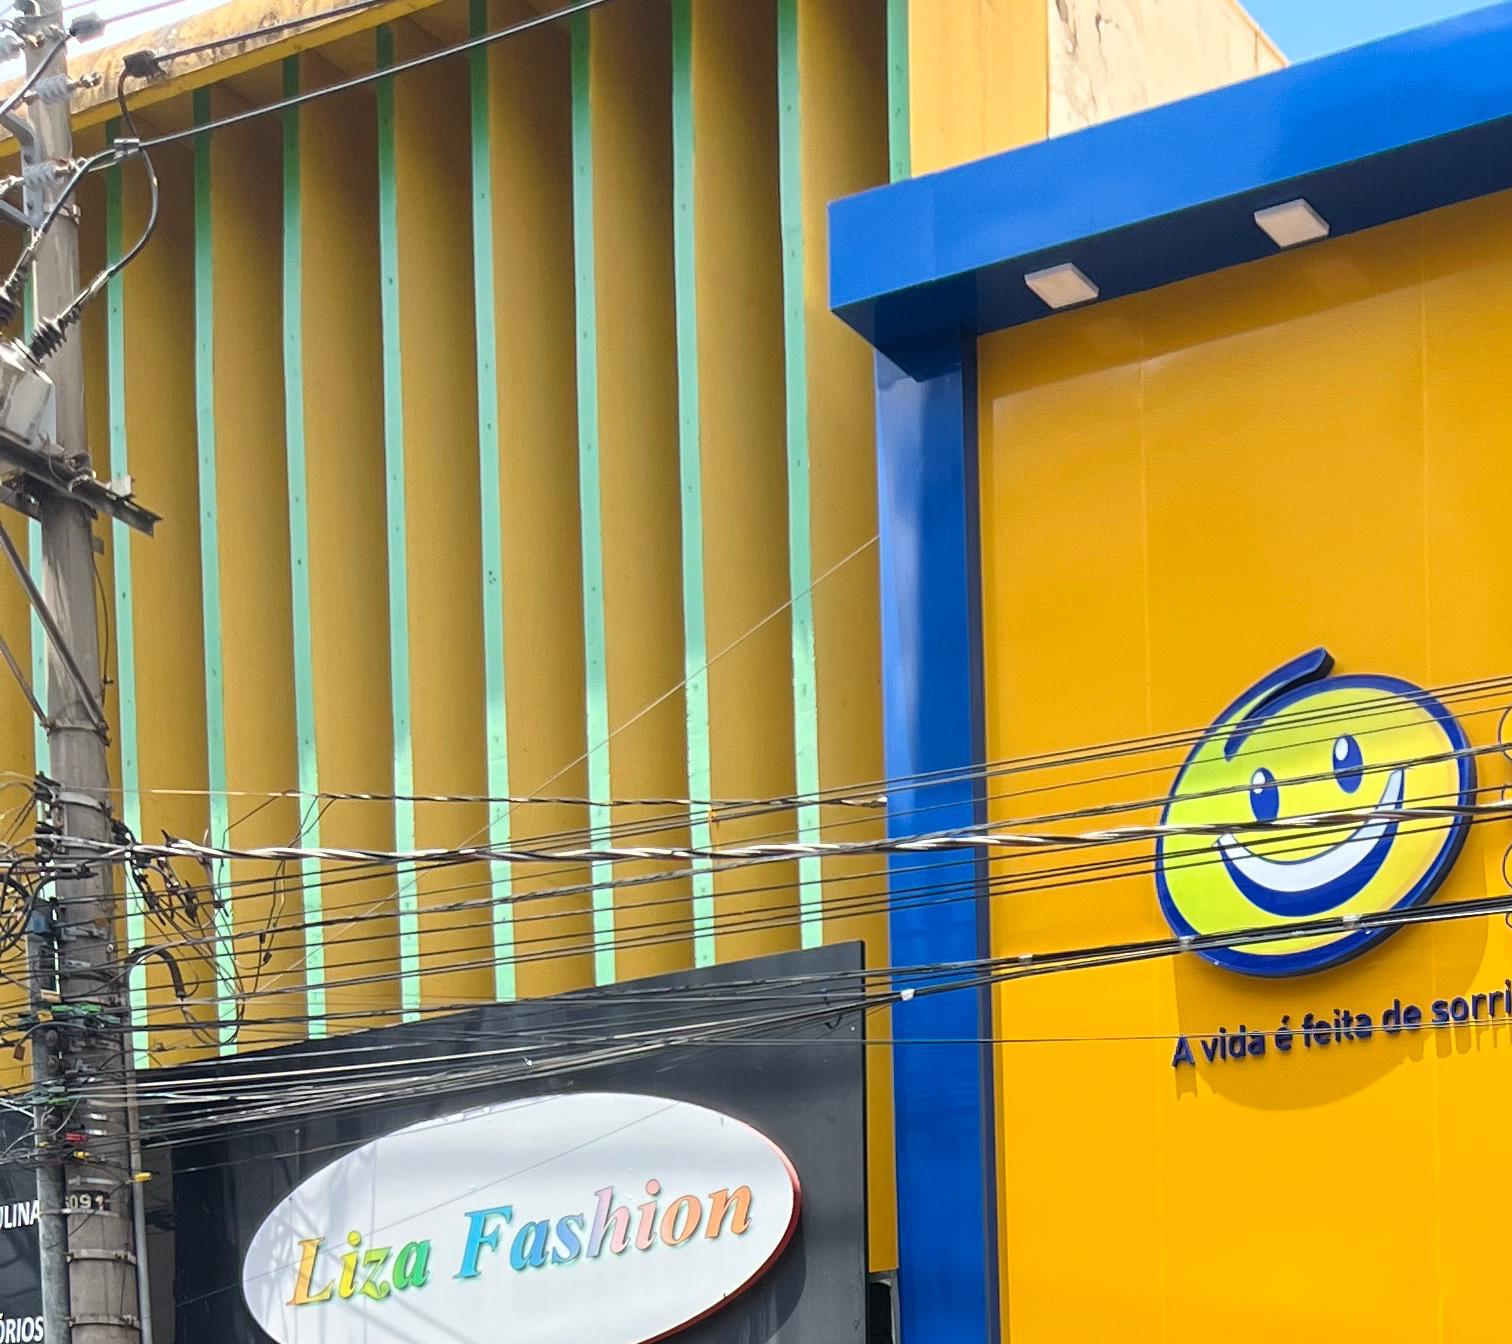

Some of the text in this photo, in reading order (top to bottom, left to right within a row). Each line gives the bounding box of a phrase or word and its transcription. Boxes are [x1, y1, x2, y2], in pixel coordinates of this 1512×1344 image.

[1172, 1033, 1196, 1069] A
[1200, 1024, 1266, 1064] vida
[1275, 1015, 1293, 1051] é
[1301, 1008, 1374, 1049] feita
[1382, 998, 1422, 1035] de
[286, 1179, 753, 1306] Liza Fashion
